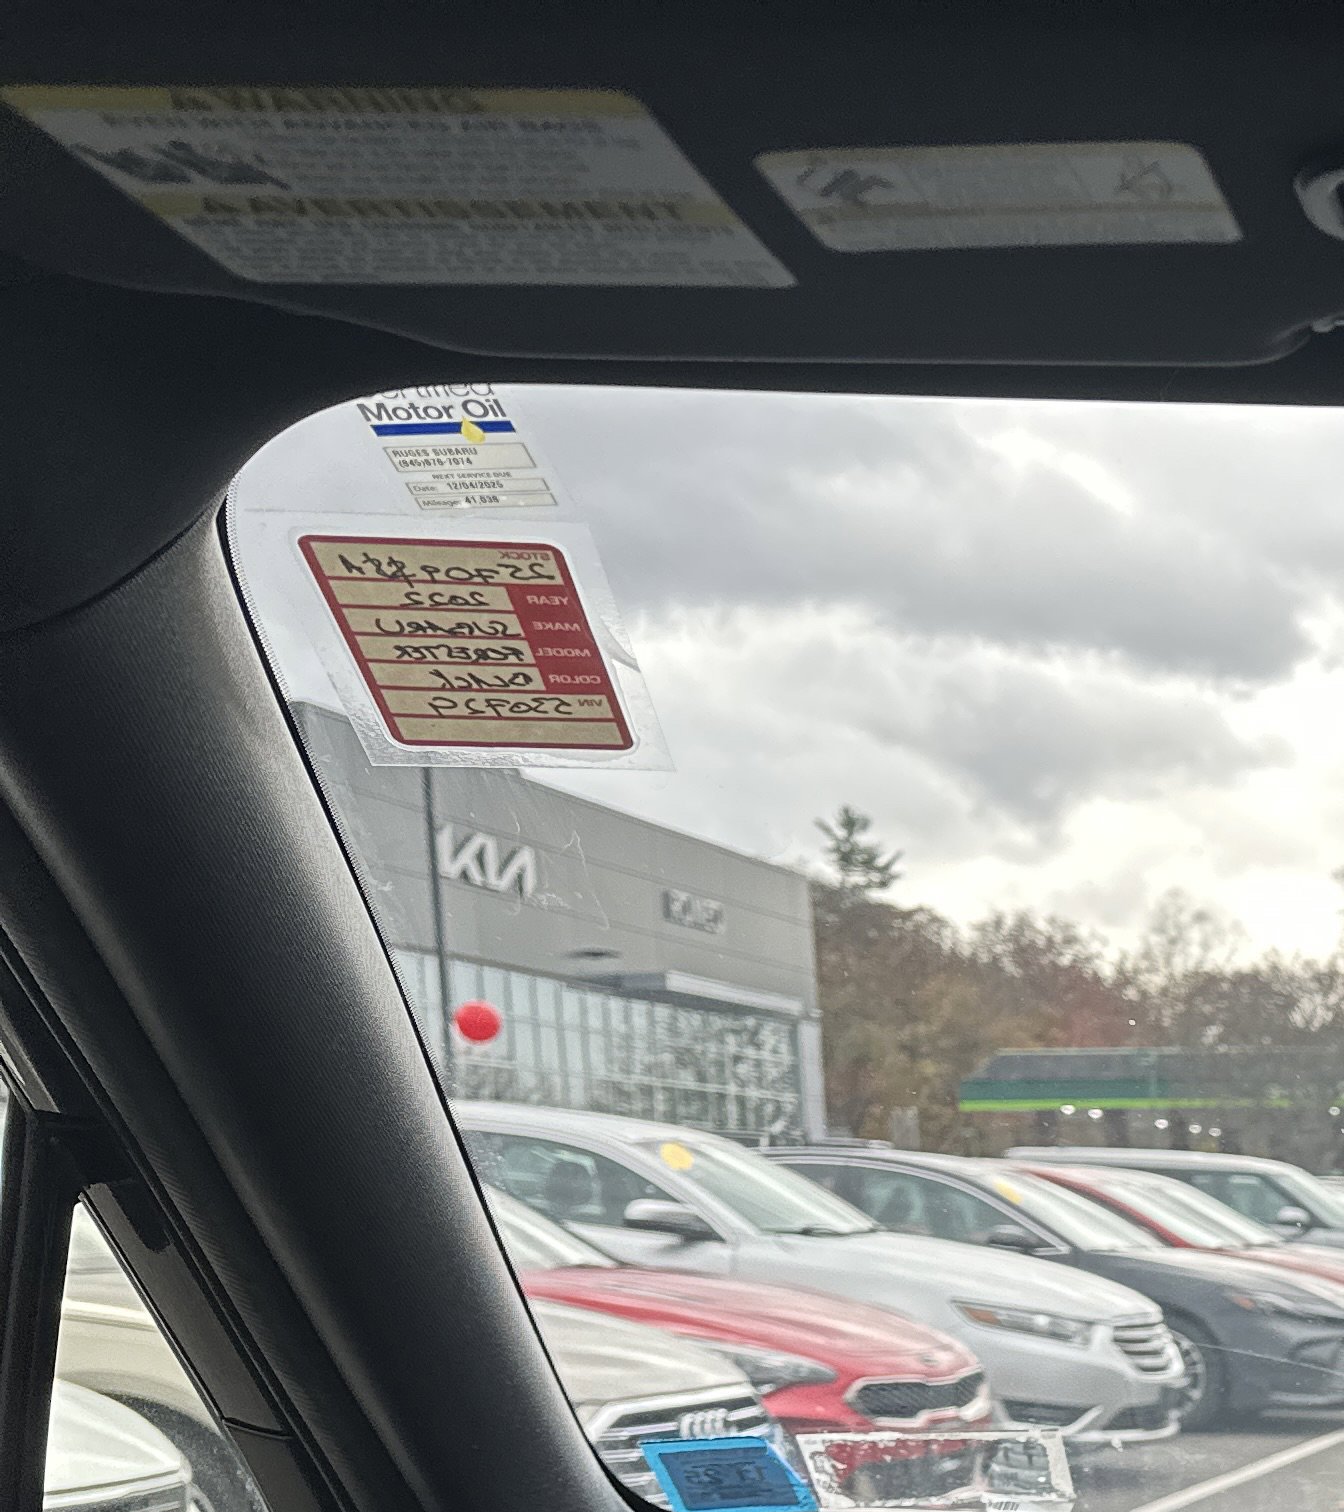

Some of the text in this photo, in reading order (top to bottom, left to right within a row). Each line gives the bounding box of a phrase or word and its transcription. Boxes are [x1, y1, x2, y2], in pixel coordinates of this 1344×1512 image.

[357, 398, 507, 422] Motor Oil
[432, 447, 479, 457] SUBARU
